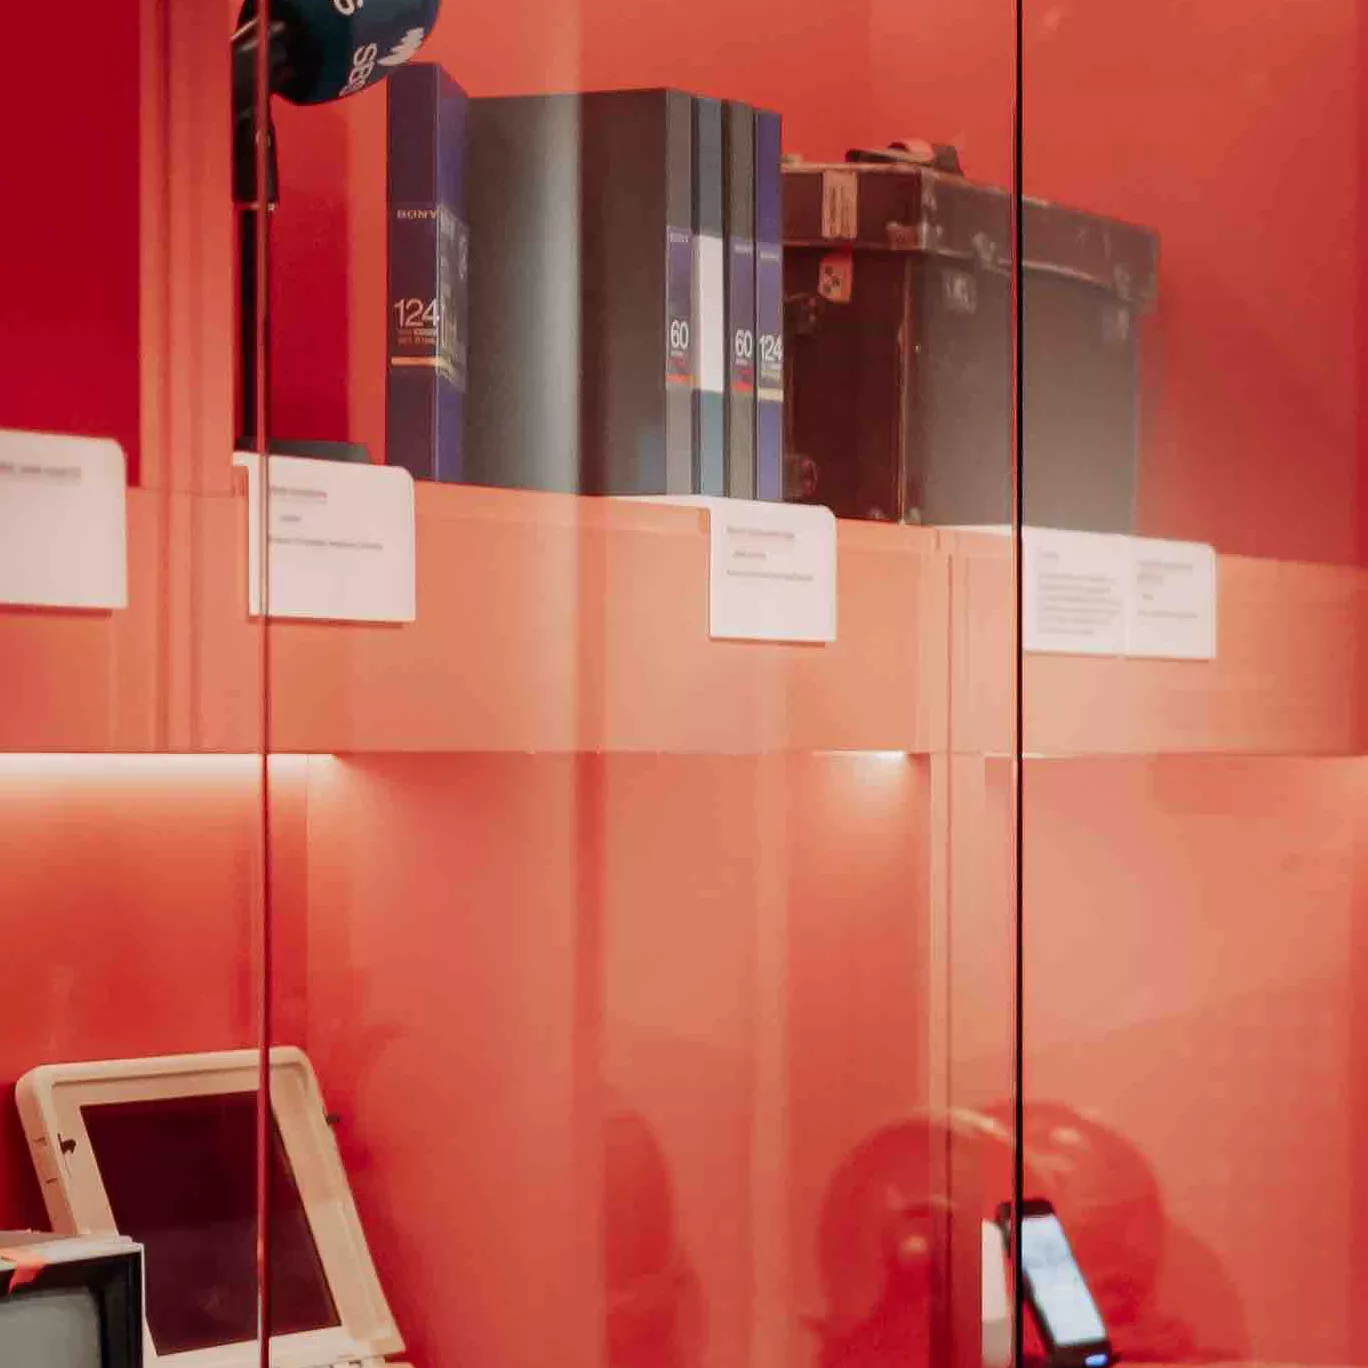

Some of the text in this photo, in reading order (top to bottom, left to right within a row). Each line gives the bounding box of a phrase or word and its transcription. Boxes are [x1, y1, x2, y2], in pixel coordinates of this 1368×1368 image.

[393, 298, 438, 327] 124
[670, 319, 689, 349] 60
[735, 329, 753, 357] 60
[759, 334, 783, 362] 124
